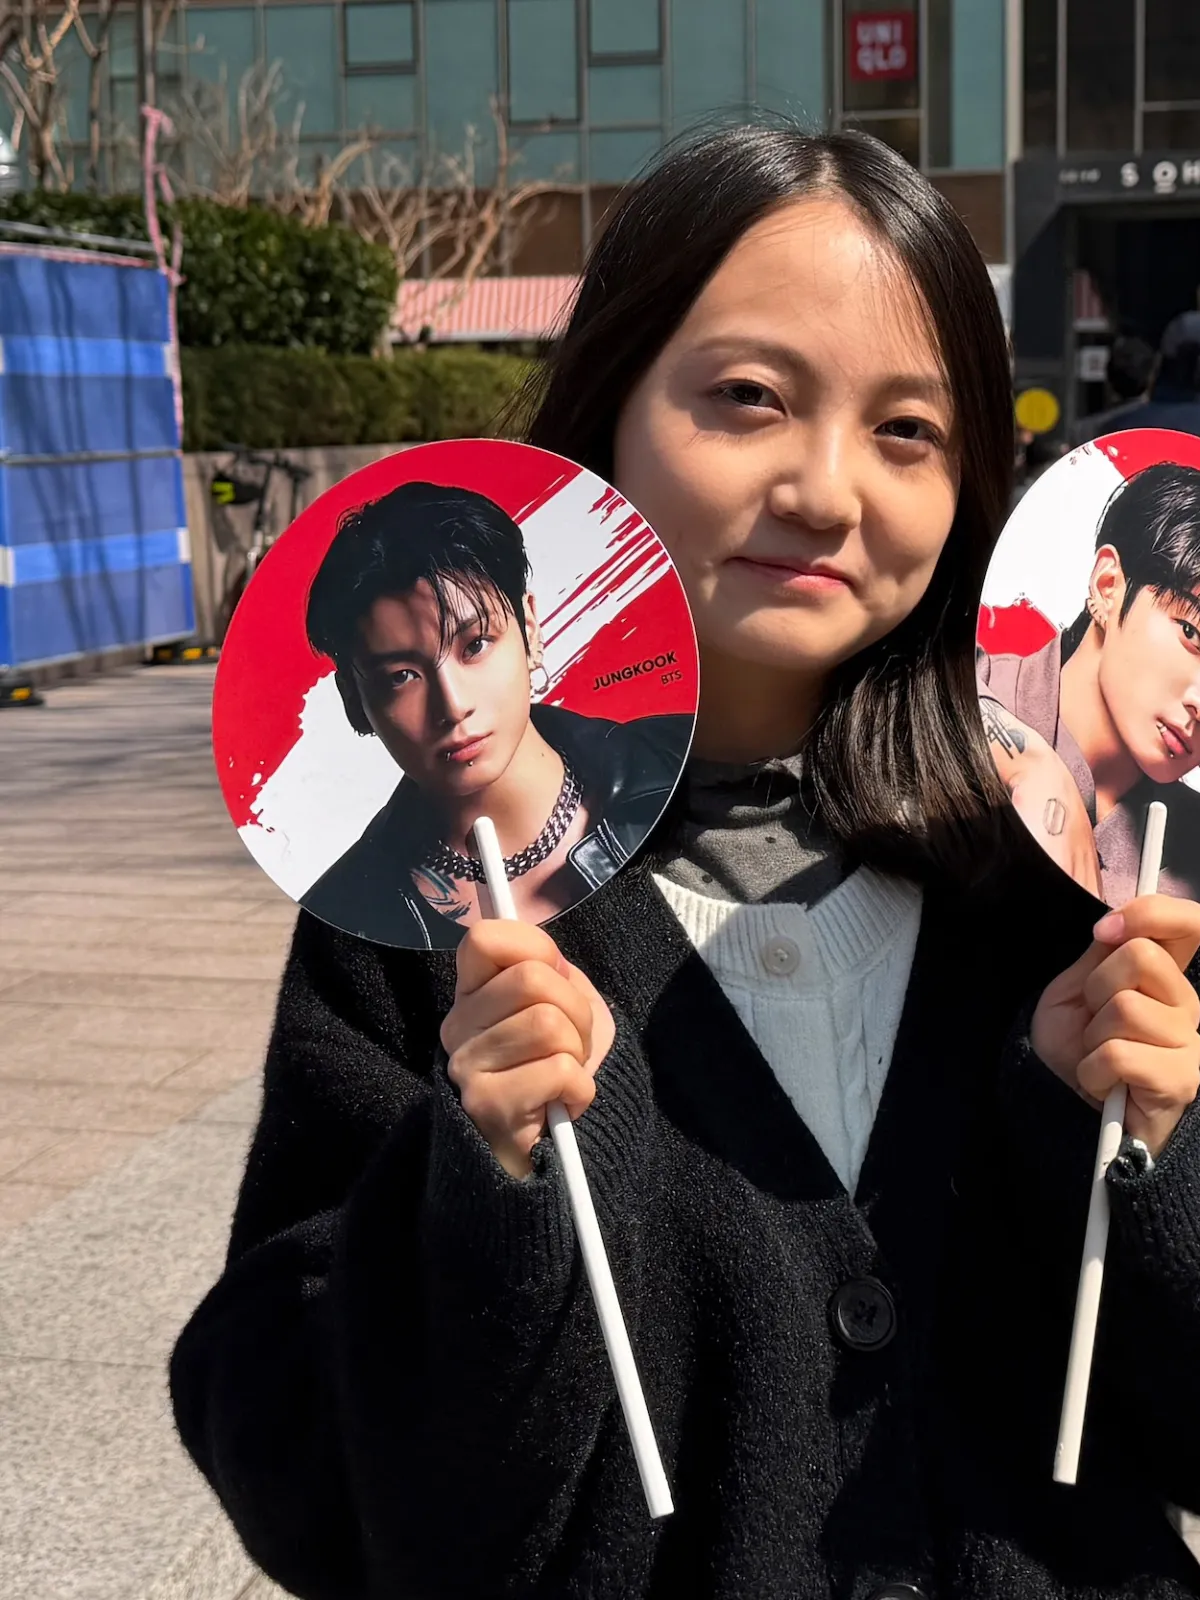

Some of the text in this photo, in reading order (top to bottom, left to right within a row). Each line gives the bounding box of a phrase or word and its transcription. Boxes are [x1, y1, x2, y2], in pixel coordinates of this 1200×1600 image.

[857, 21, 902, 45] UNI
[857, 45, 907, 75] QLO
[593, 651, 677, 691] JUNGKOOK
[661, 670, 682, 685] BTS
